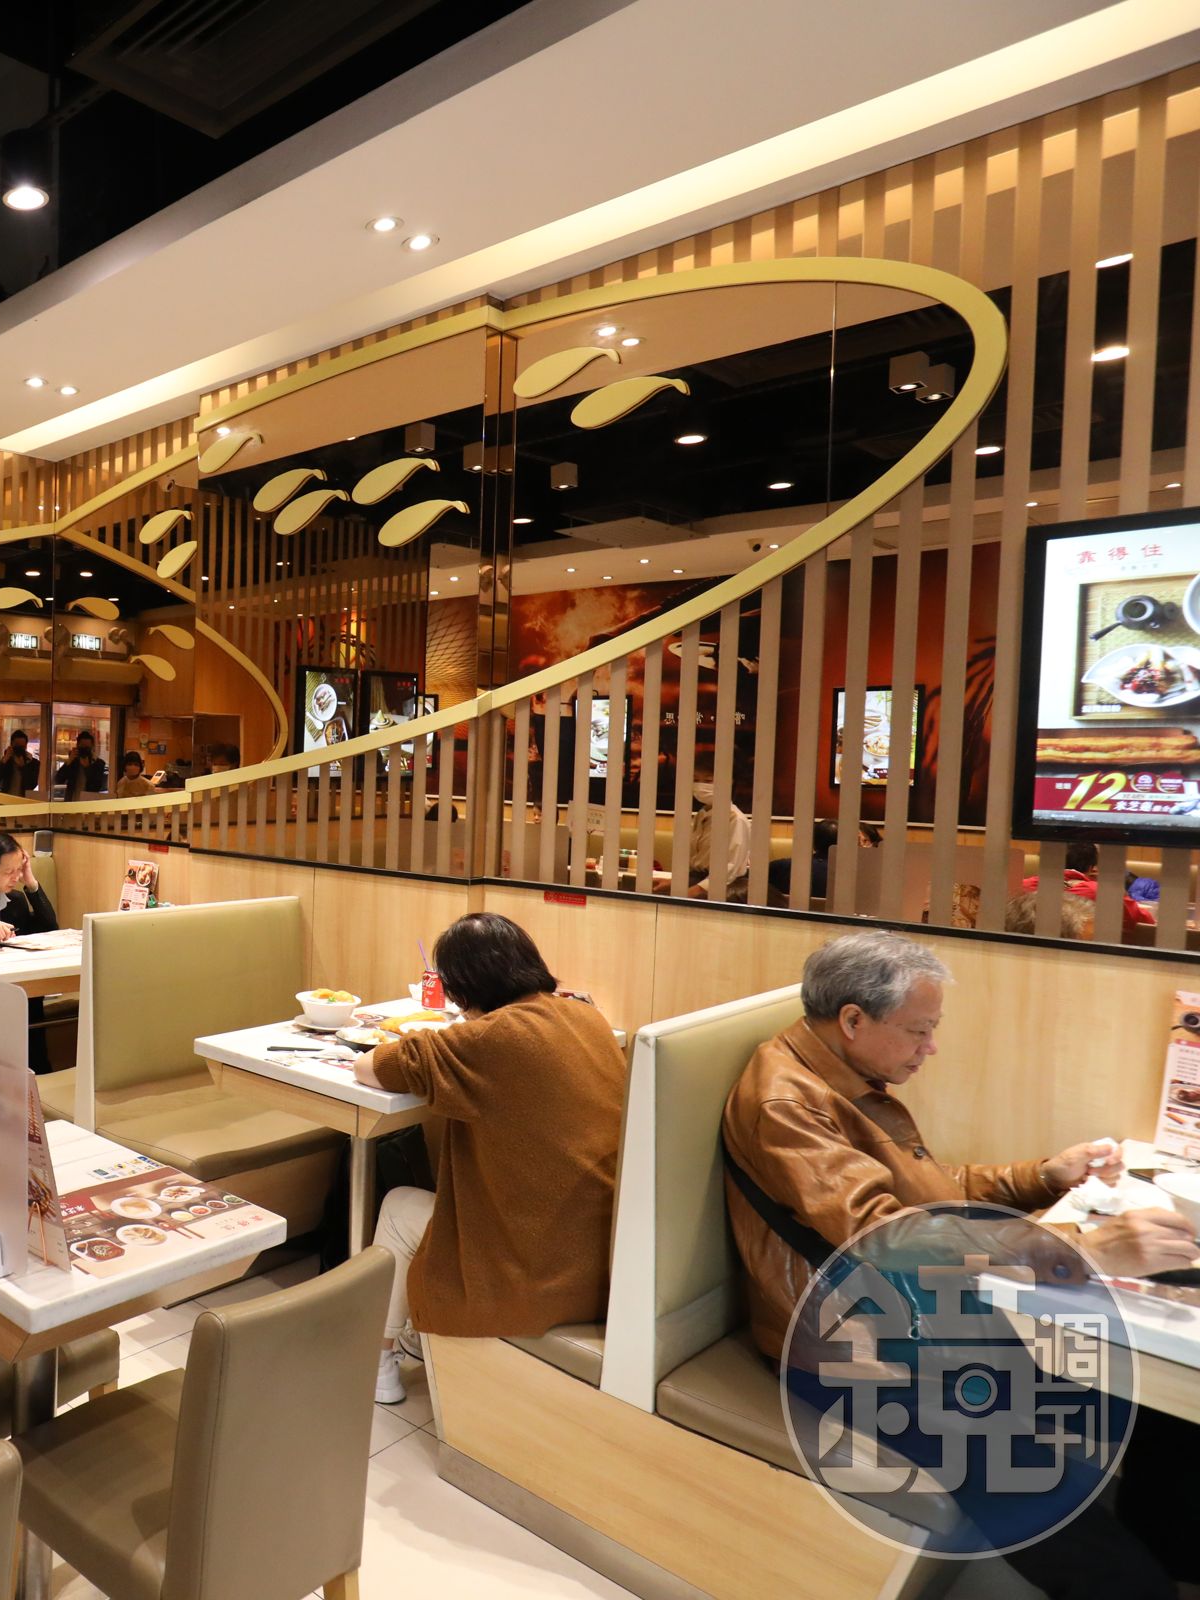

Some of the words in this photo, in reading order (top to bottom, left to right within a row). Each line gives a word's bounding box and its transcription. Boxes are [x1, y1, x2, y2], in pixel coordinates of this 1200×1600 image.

[1076, 543, 1163, 564] 靠得住
[1063, 771, 1127, 811] 12
